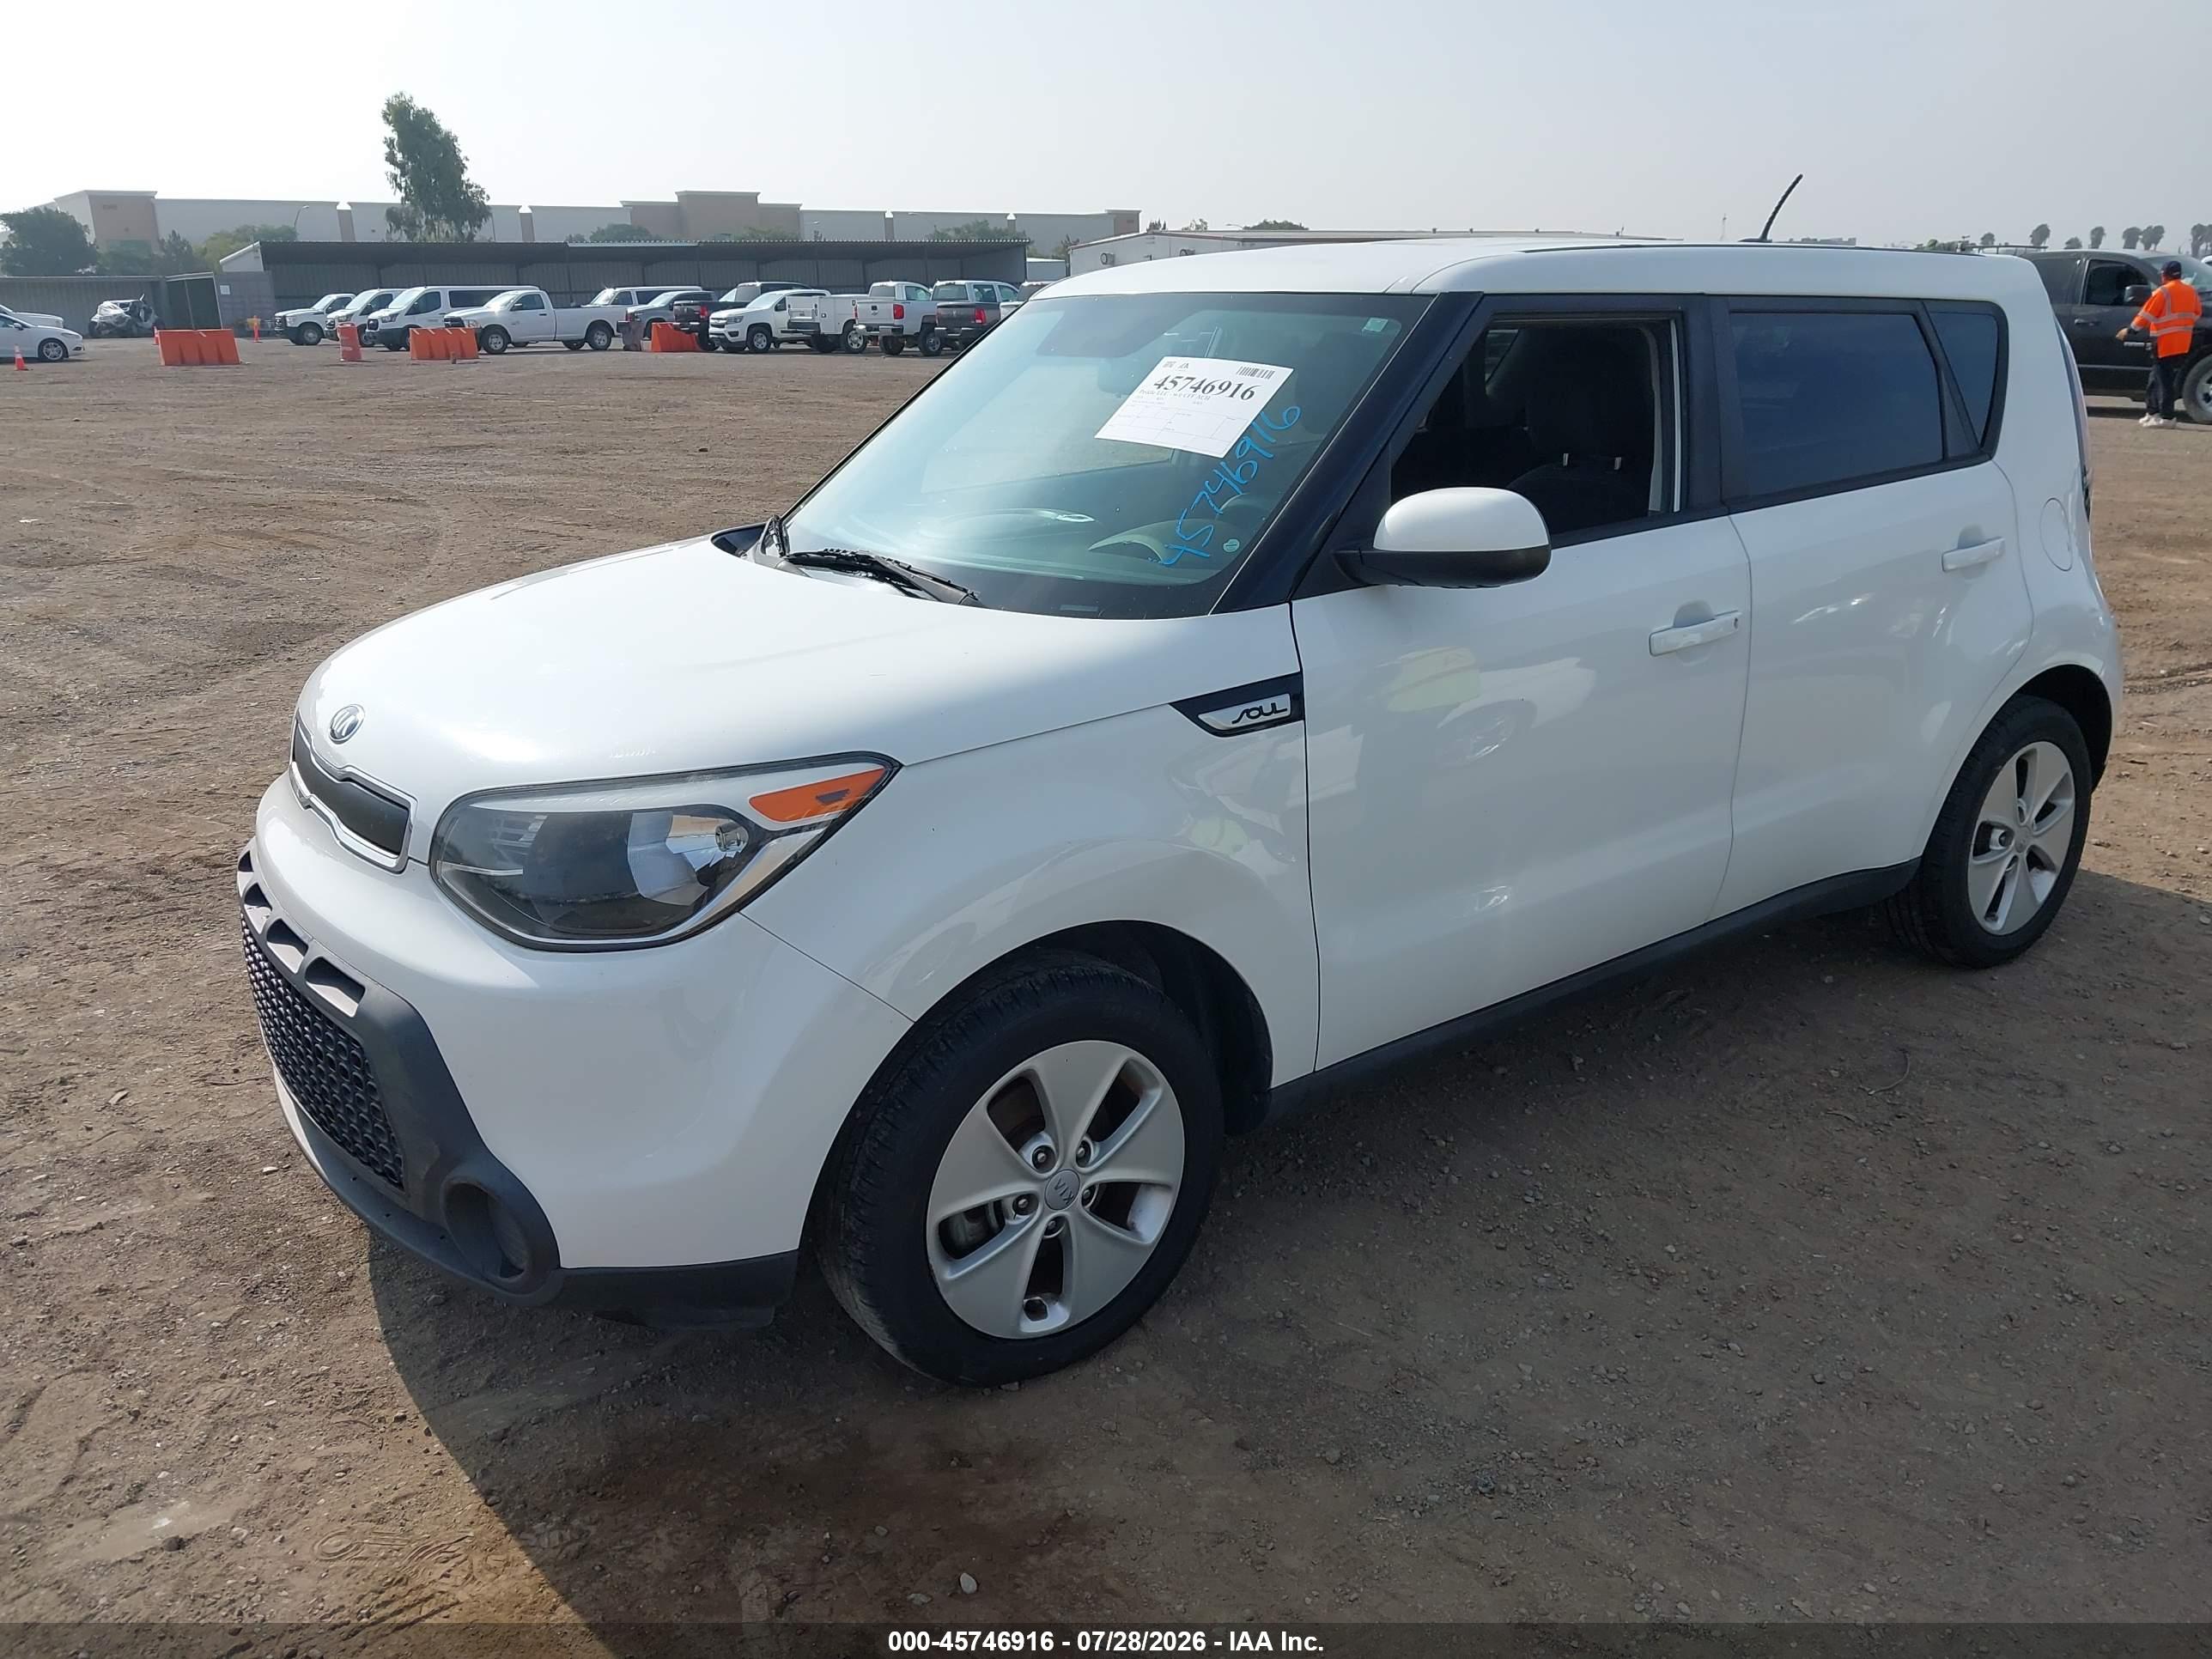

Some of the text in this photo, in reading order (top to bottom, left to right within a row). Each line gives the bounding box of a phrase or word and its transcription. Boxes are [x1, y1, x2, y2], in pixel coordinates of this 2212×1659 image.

[1154, 374, 1264, 401] 45746916
[1162, 405, 1302, 566] 45746916
[1231, 702, 1288, 725] SOUL
[1054, 1177, 1075, 1206] KIA
